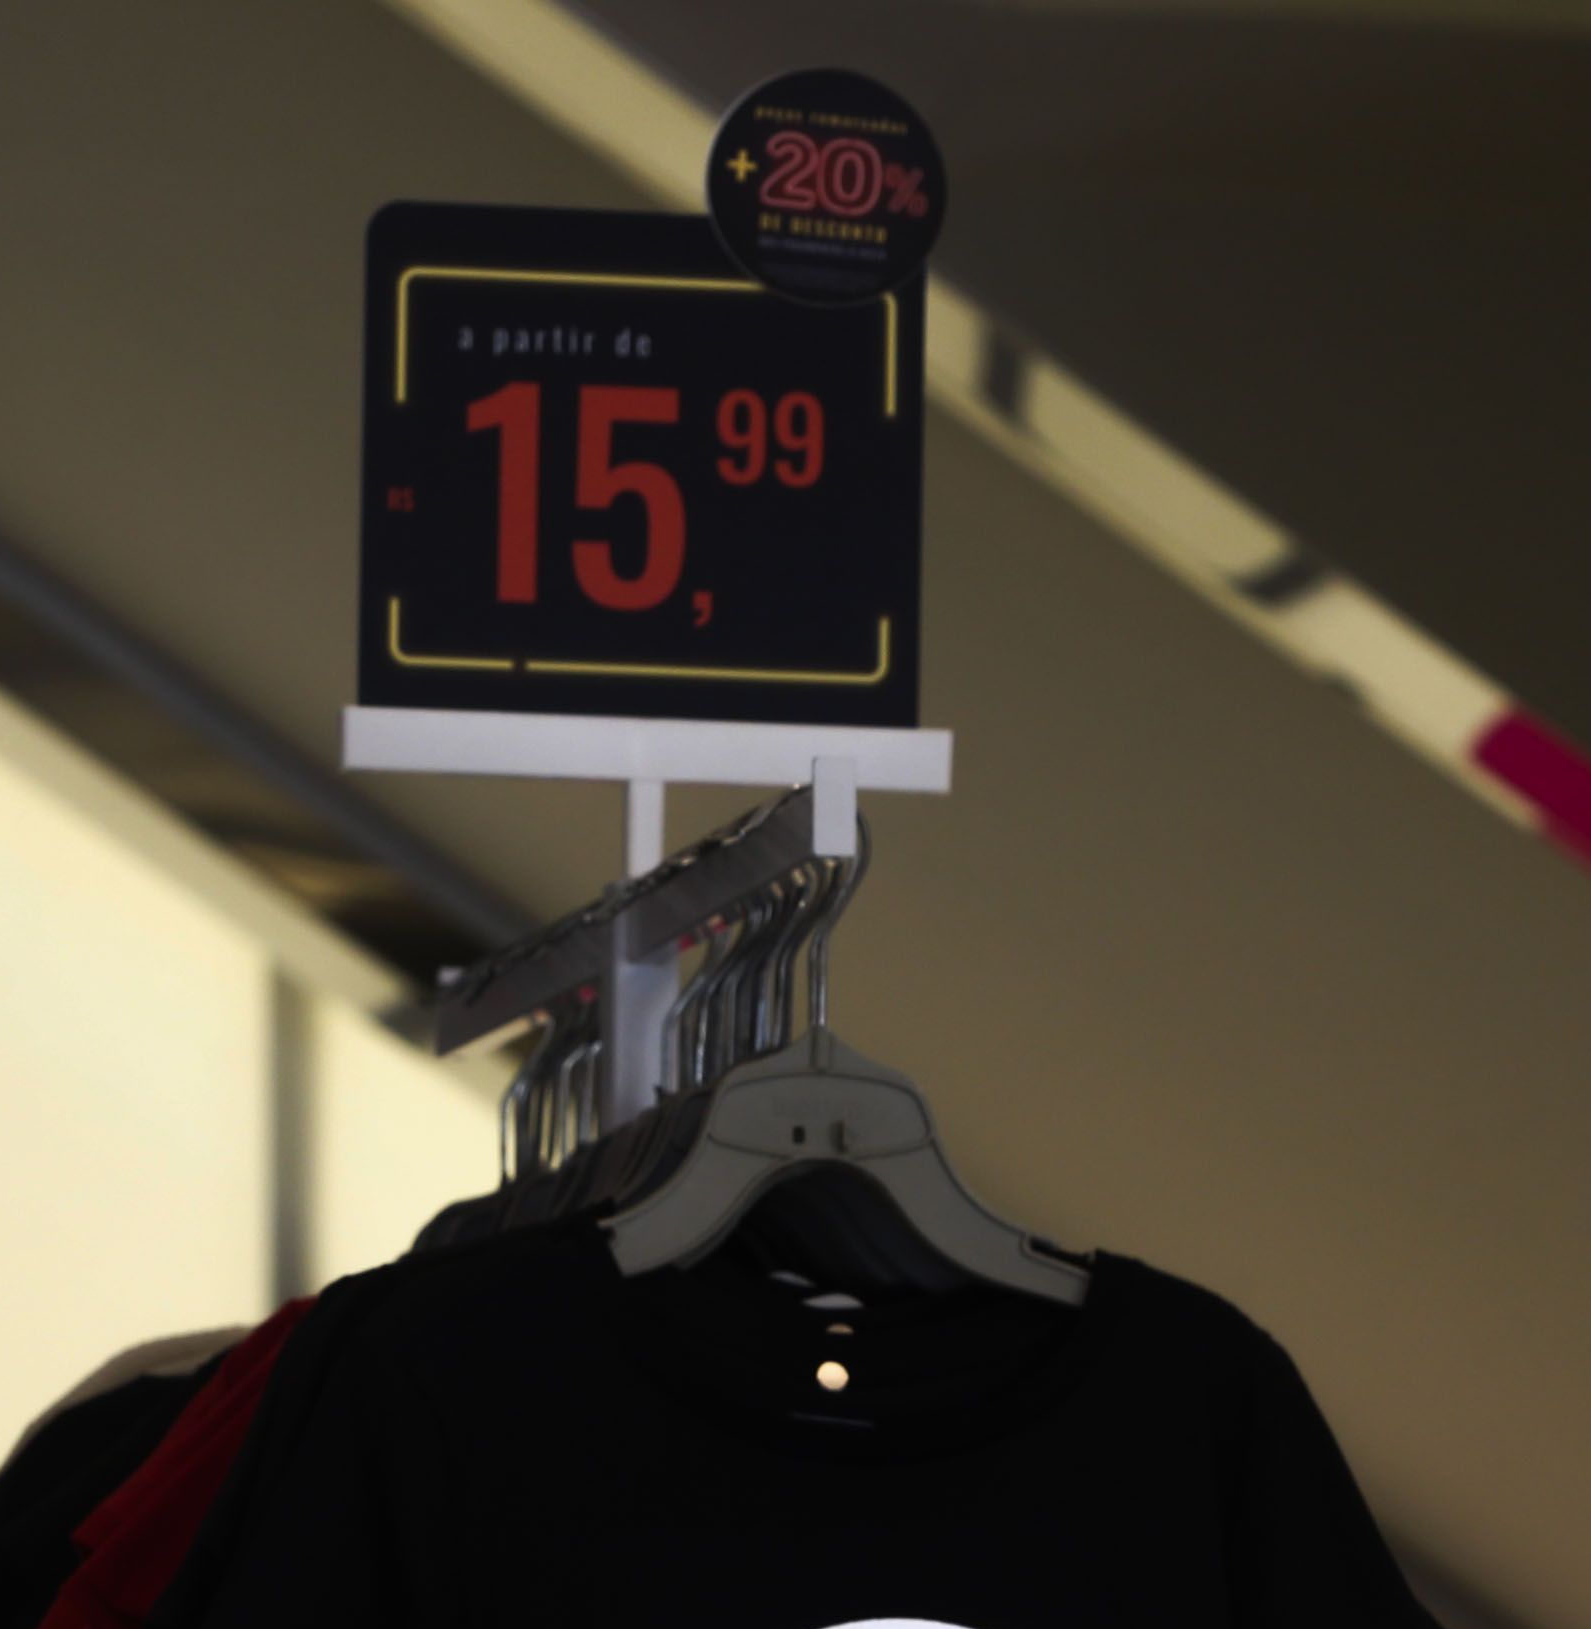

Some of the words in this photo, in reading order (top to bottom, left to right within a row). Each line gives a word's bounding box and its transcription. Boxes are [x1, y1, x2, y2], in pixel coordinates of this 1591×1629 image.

[790, 216, 889, 245] DESCONTO
[458, 325, 475, 350] a
[492, 325, 596, 357] partir
[615, 326, 653, 359] de
